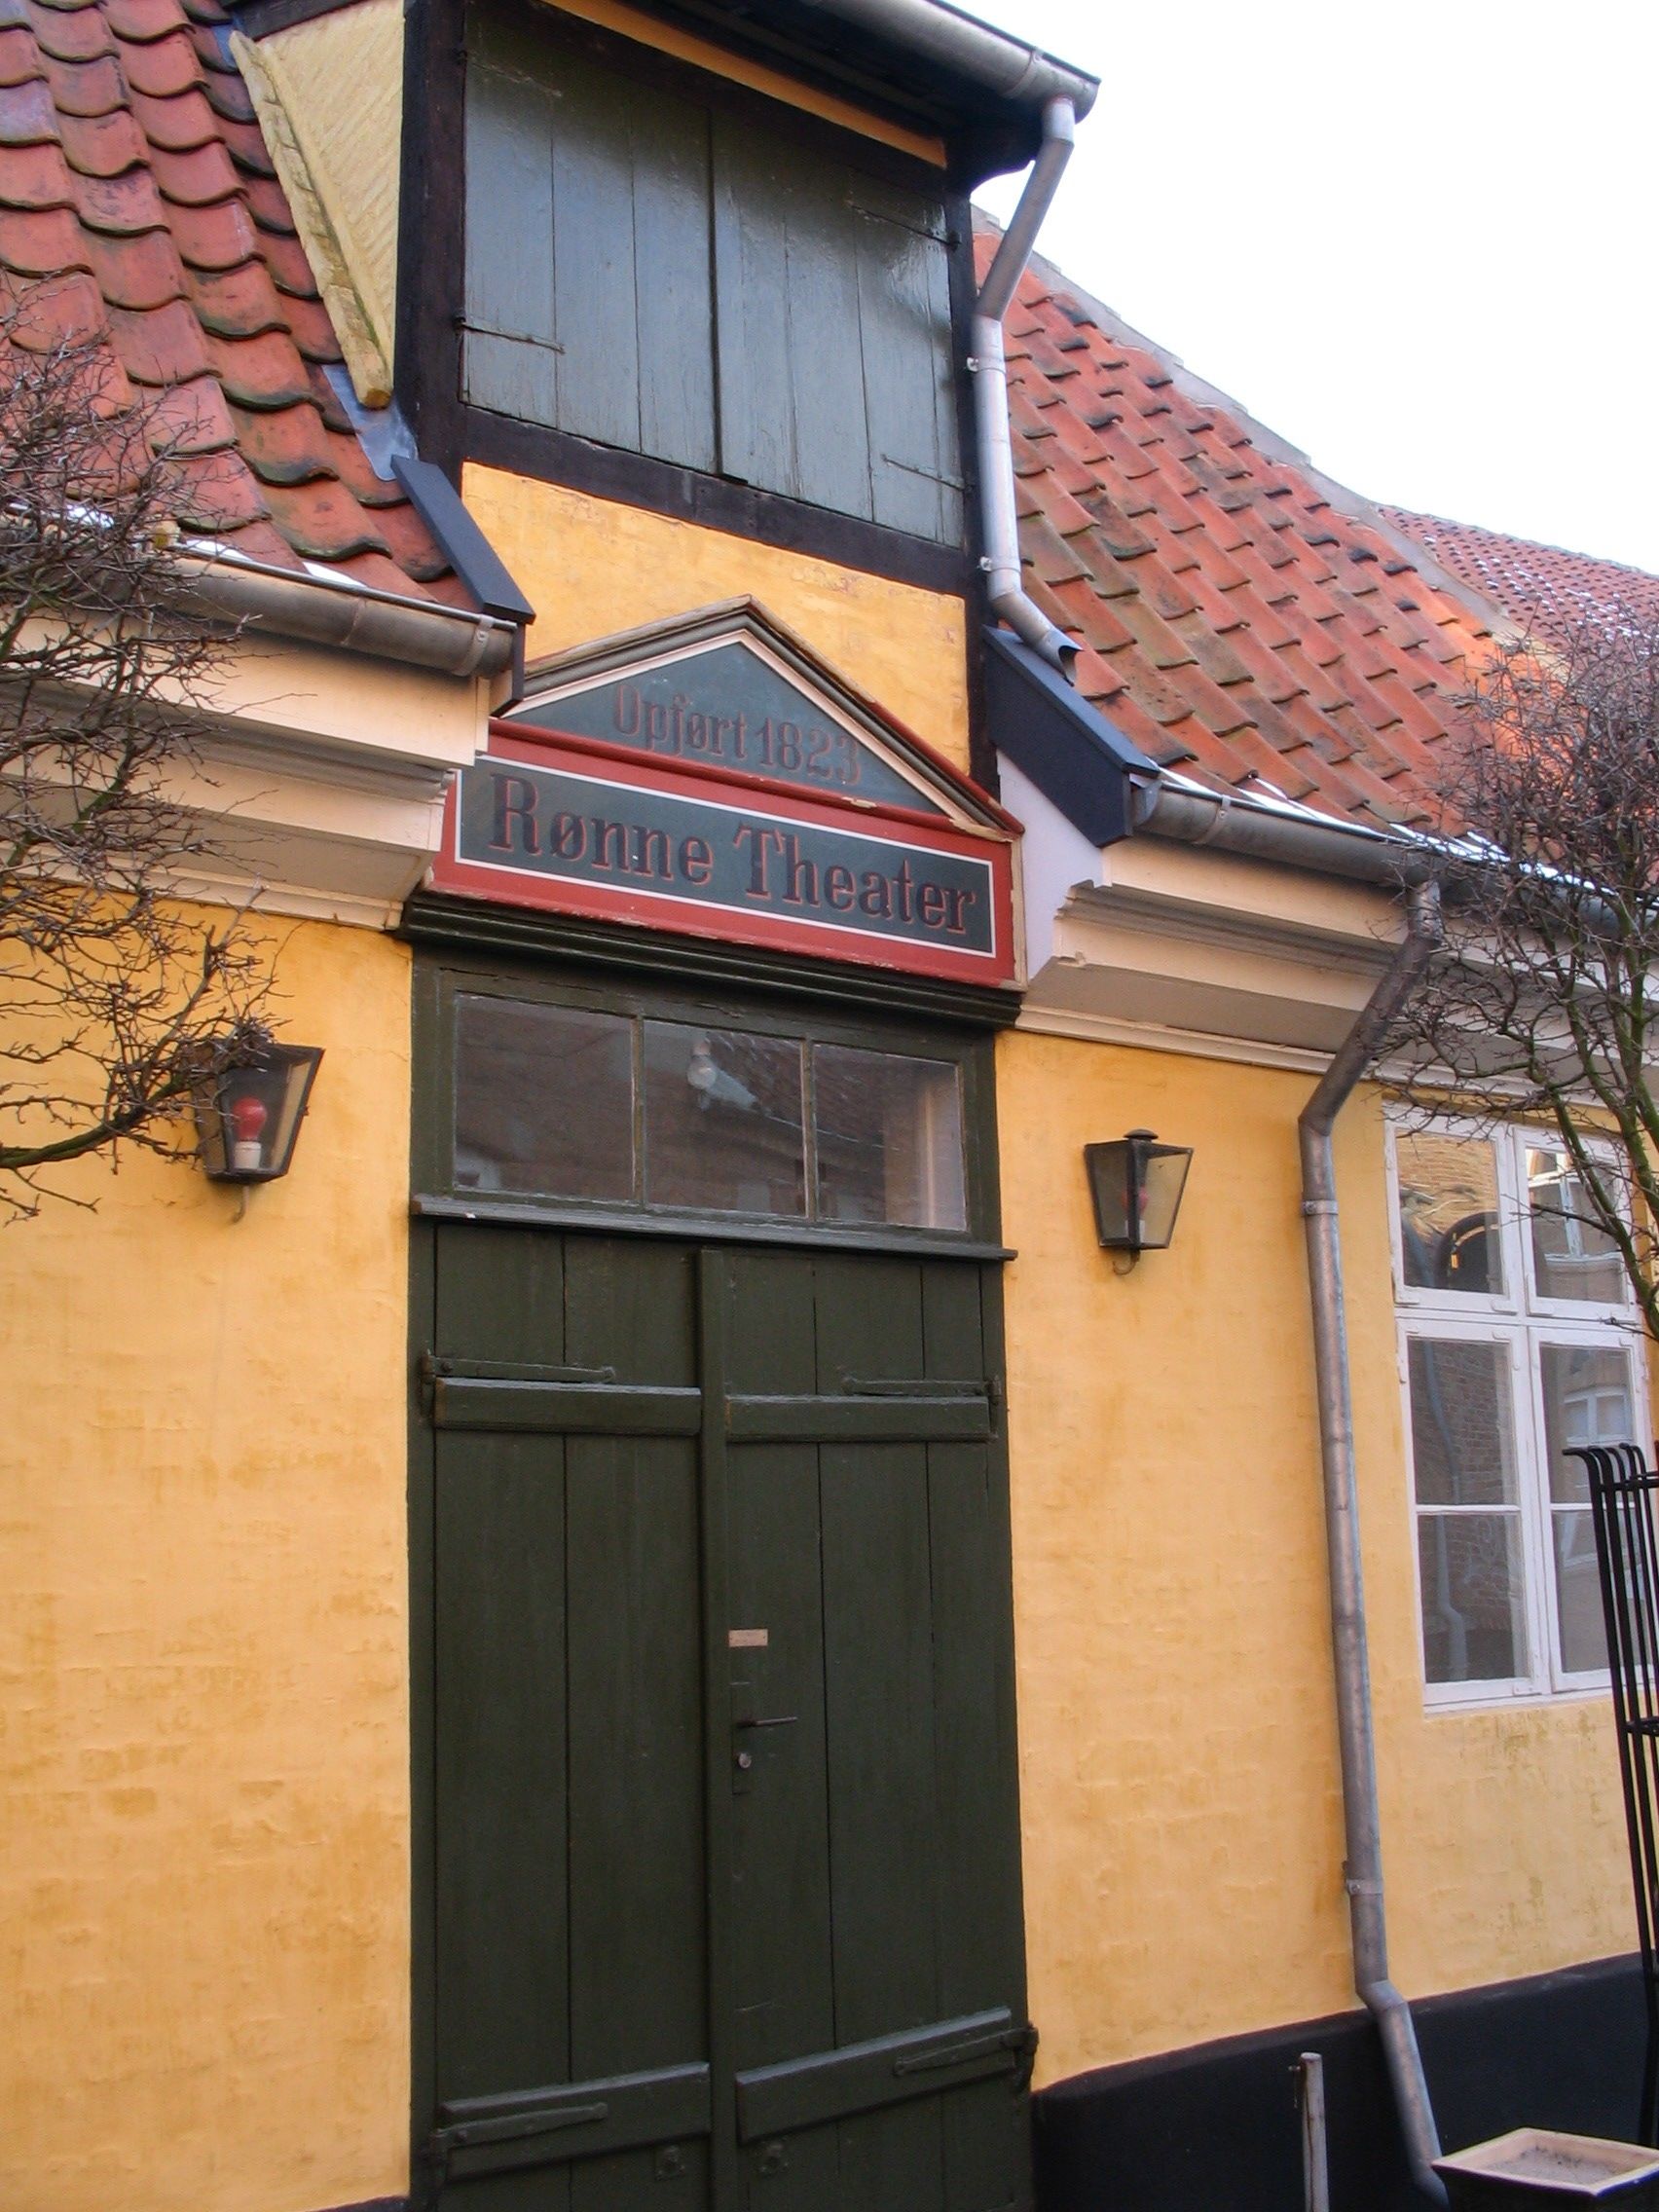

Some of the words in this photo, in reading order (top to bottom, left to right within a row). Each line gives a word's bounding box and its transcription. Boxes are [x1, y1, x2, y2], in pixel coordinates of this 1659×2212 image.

[613, 683, 748, 756] Opført
[756, 717, 862, 785] 1823
[489, 773, 714, 886] Rønne
[733, 822, 977, 935] Theater
